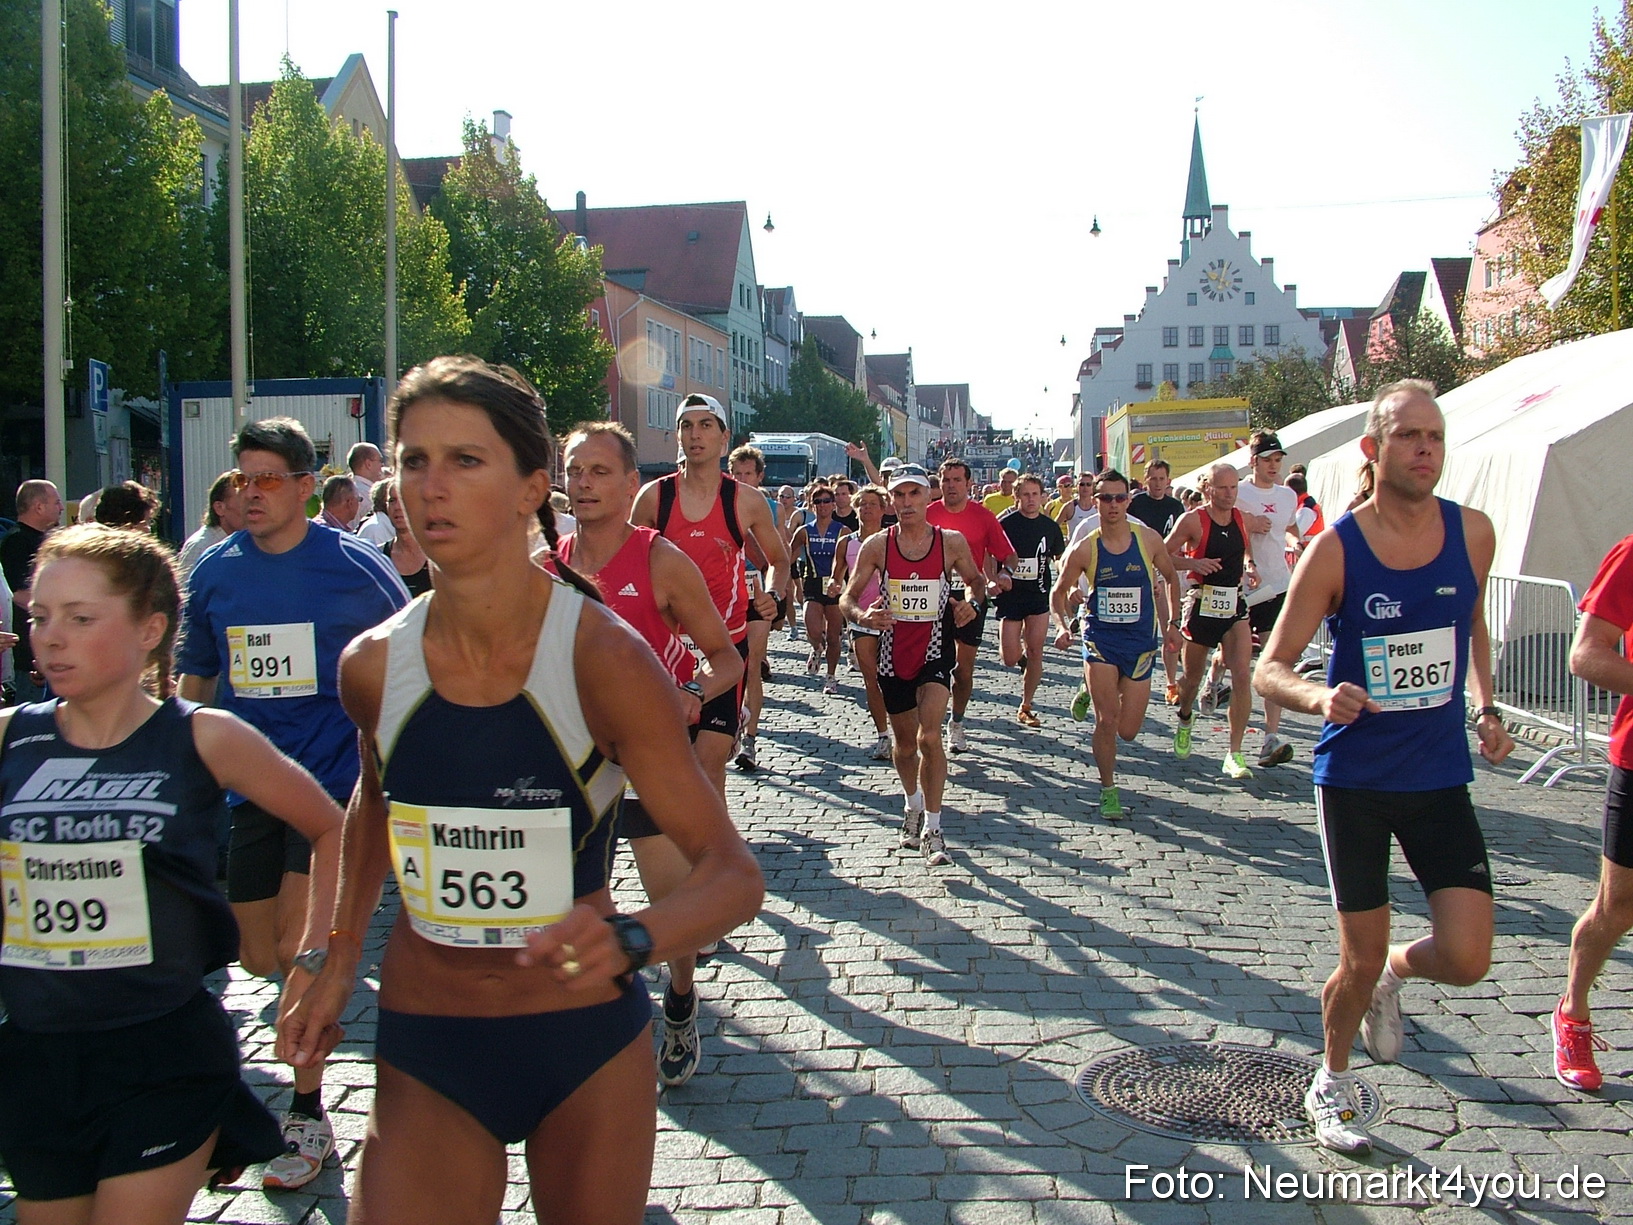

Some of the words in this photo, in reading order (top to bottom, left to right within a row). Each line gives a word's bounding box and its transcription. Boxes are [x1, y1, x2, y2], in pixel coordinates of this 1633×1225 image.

[94, 366, 104, 404] P
[901, 584, 929, 593] Herbert
[1107, 591, 1134, 599] Andreas
[902, 597, 928, 610] 978
[1108, 602, 1138, 614] 3335
[1211, 599, 1231, 610] 333
[247, 633, 271, 647] Ralf
[1388, 642, 1424, 658] Peter
[234, 653, 243, 665] A
[250, 655, 292, 678] 991
[1371, 665, 1382, 677] C
[1393, 660, 1452, 690] 2867
[36, 778, 165, 801] NAGEL
[8, 816, 49, 843] SC
[54, 813, 122, 842] Roth
[125, 814, 166, 843] 52
[431, 822, 525, 851] Kathrin
[25, 857, 124, 881] Christine
[403, 857, 421, 879] A
[8, 886, 21, 908] A
[440, 869, 528, 909] 563
[34, 898, 108, 934] 899
